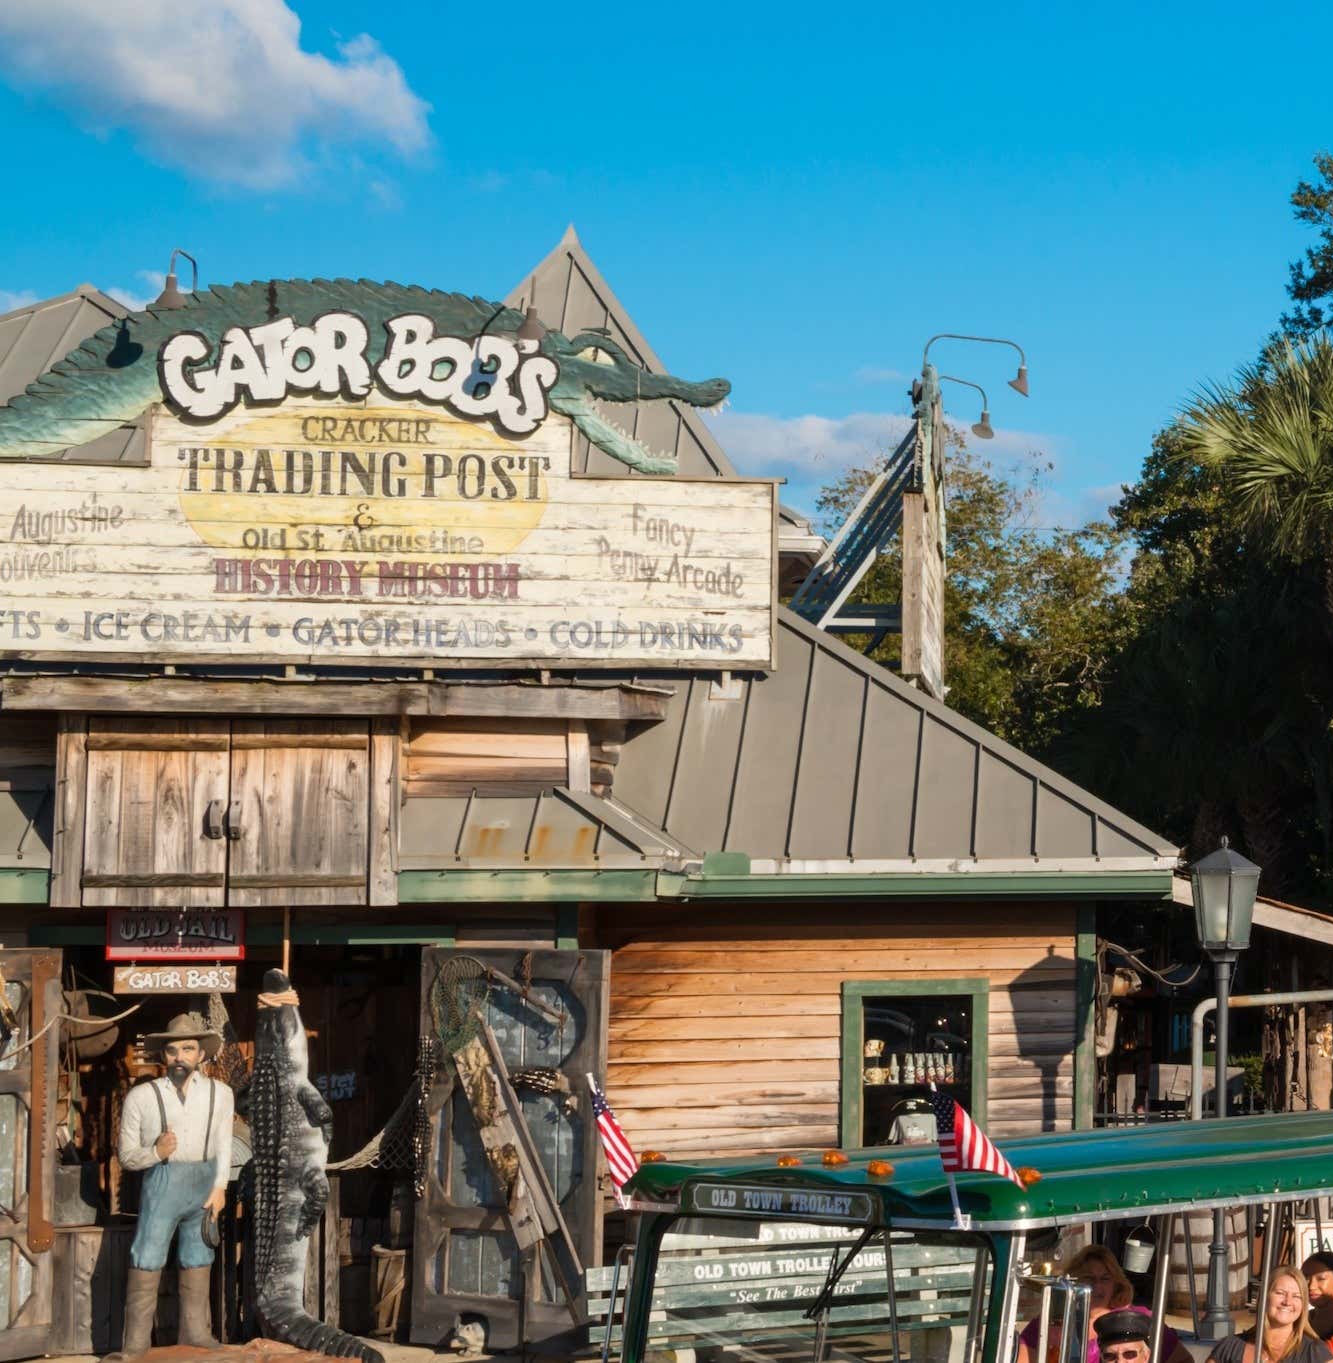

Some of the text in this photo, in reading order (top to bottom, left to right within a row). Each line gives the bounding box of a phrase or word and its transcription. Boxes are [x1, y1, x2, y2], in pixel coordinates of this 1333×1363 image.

[160, 311, 372, 422] GATOR
[302, 416, 432, 444] CRACKER
[178, 448, 551, 501] TRADING POST
[11, 493, 125, 541] Augustine
[353, 503, 374, 531] &
[630, 502, 695, 557] Fancy
[242, 528, 287, 550] Old
[341, 530, 484, 554] Augustine
[213, 558, 520, 599] HISTORY MUSEUM
[596, 536, 744, 599] Penny Arcade
[83, 611, 131, 642] ICE
[141, 614, 252, 644] CREAM
[292, 617, 402, 647] GATOR
[412, 619, 512, 648] HEADS
[550, 620, 629, 650] COLD
[639, 621, 744, 652] DRINKS
[119, 915, 235, 944] OLD JAIL
[128, 968, 231, 989] GATOR BOB'S
[711, 1188, 853, 1215] OLD TOWN TROLLEY
[779, 1227, 820, 1240] TOWN
[694, 1264, 724, 1280] OLD
[730, 1261, 772, 1277] TOWN
[776, 1257, 837, 1273] TROLLE
[766, 1288, 788, 1300] The
[794, 1285, 821, 1299] Best
